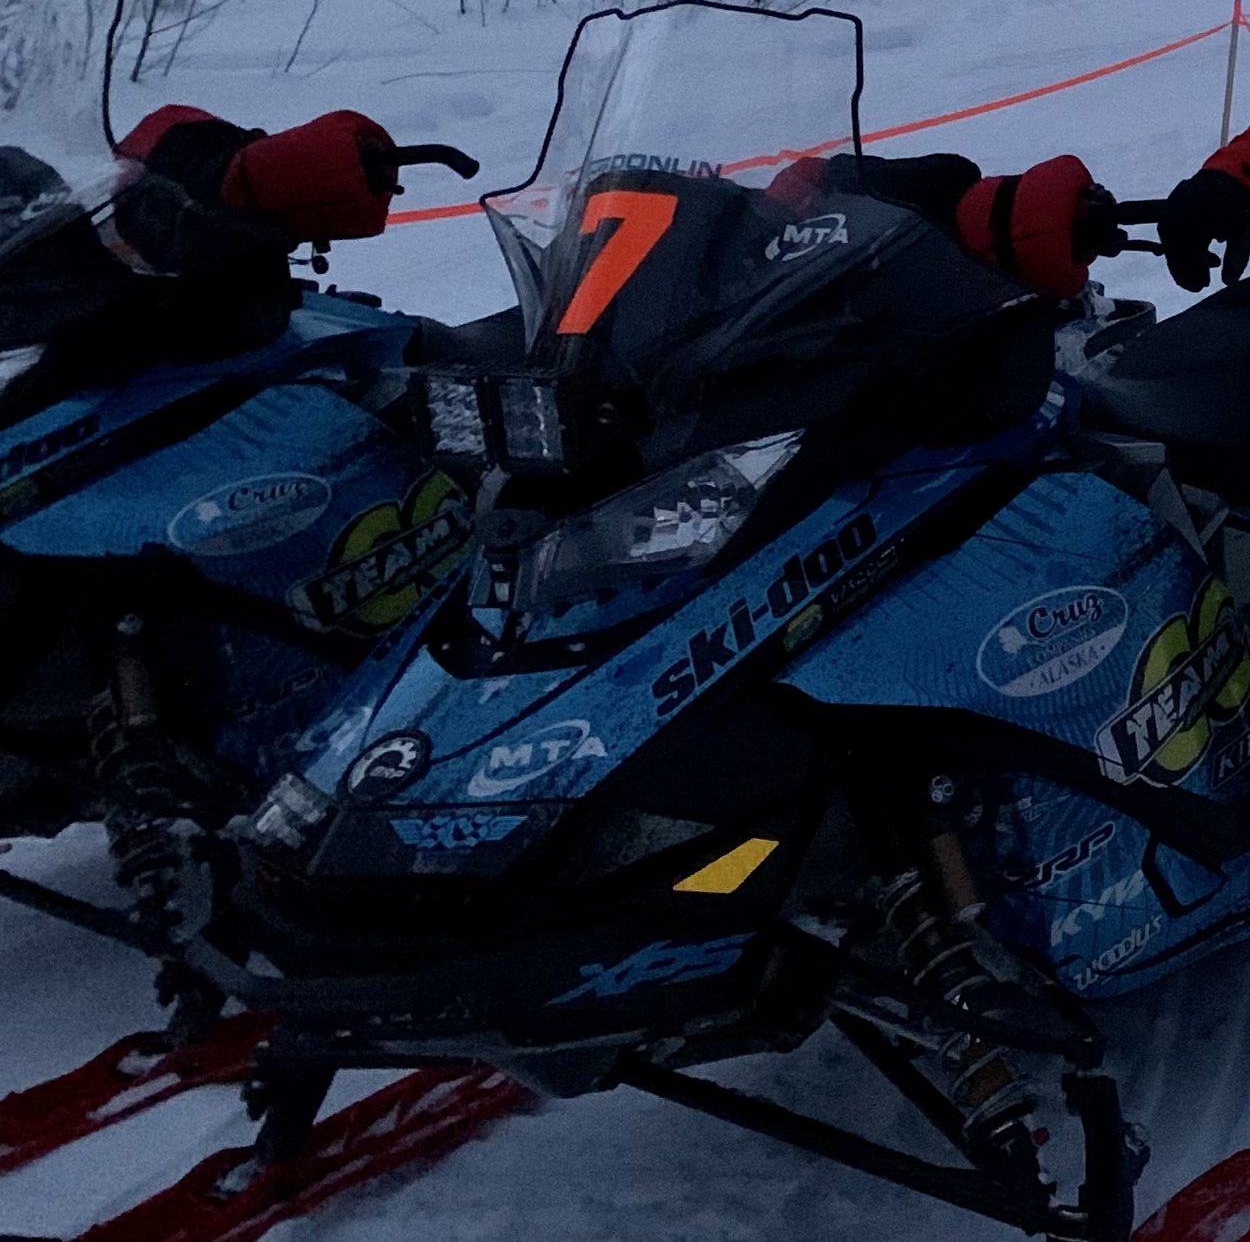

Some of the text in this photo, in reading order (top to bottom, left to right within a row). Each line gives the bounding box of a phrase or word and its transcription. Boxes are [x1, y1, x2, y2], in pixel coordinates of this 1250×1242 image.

[557, 189, 679, 335] 7
[783, 222, 849, 246] MTA
[321, 517, 452, 616] TEAM
[1027, 595, 1102, 638] Cruz
[1126, 630, 1231, 761] TEAM
[490, 736, 608, 769] MTA
